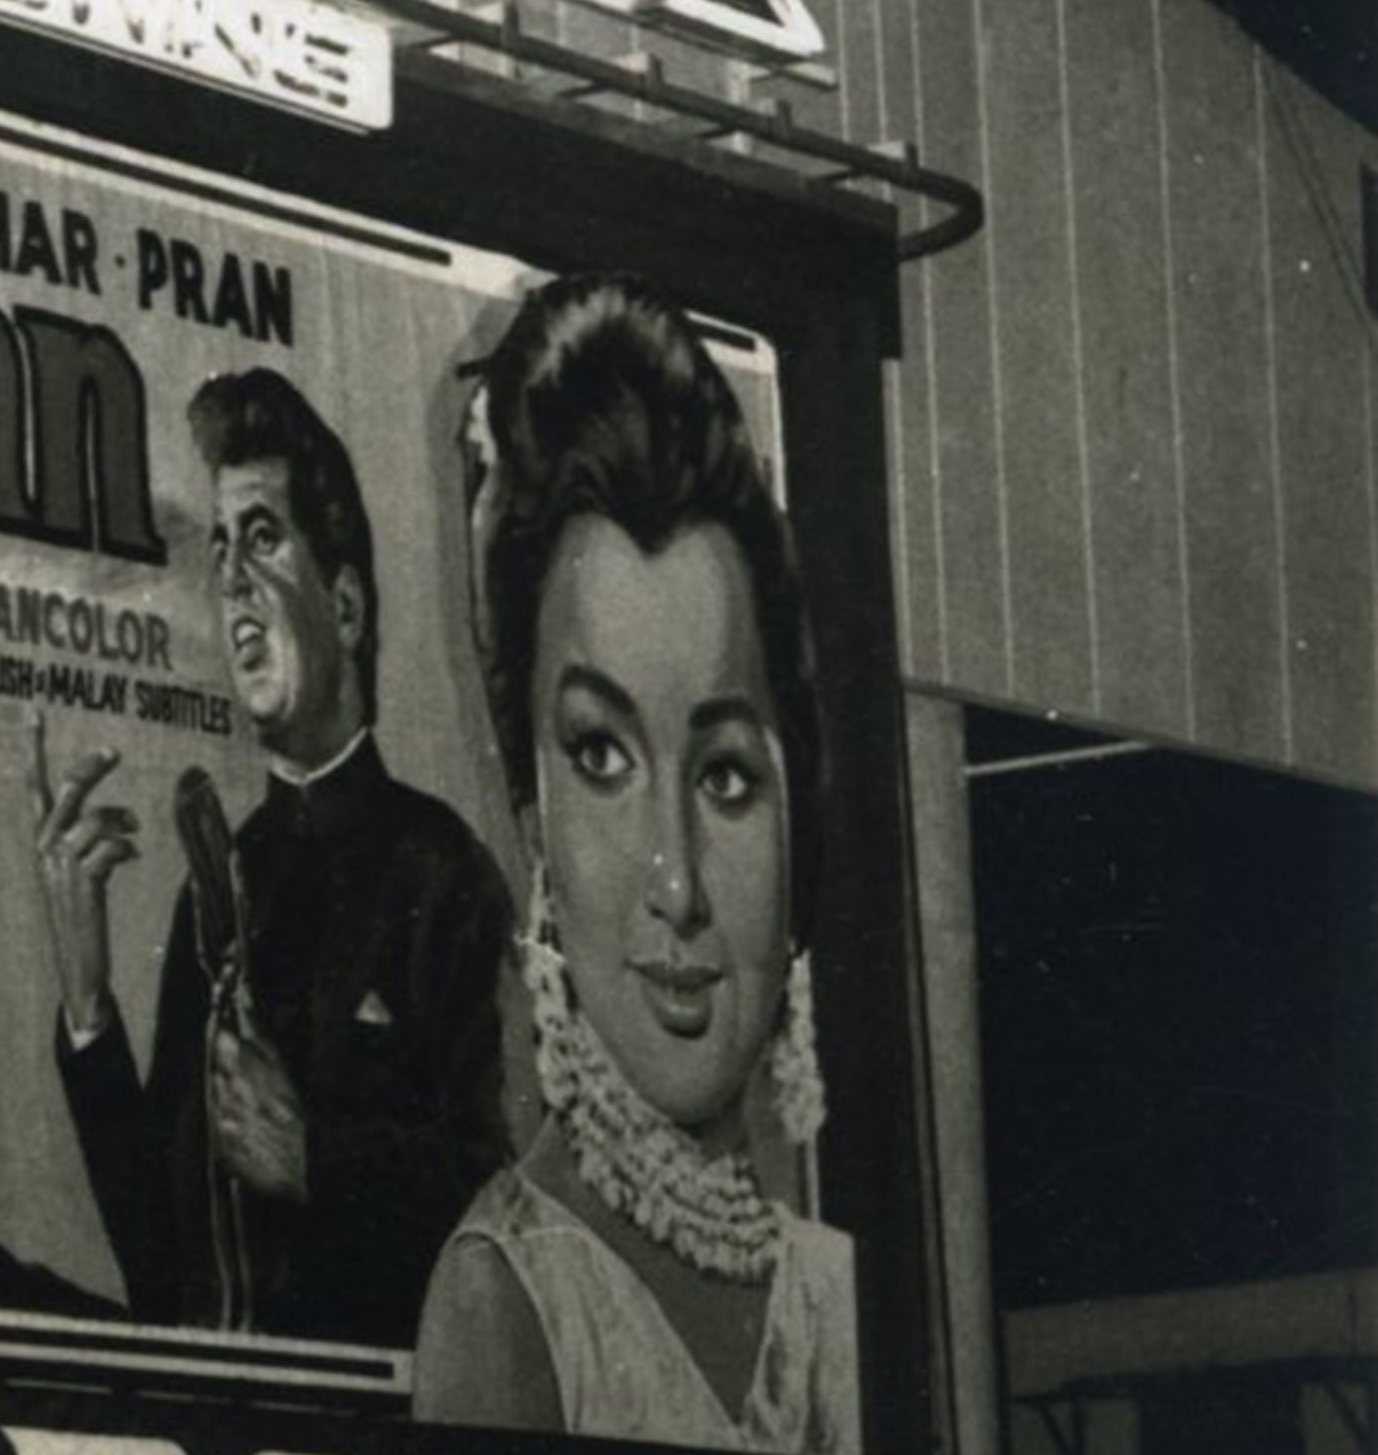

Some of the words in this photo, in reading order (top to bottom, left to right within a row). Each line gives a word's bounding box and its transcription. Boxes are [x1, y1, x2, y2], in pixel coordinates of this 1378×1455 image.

[136, 227, 293, 346] PRAN
[47, 662, 129, 716] MALAY
[135, 678, 233, 737] SUBTITLES
